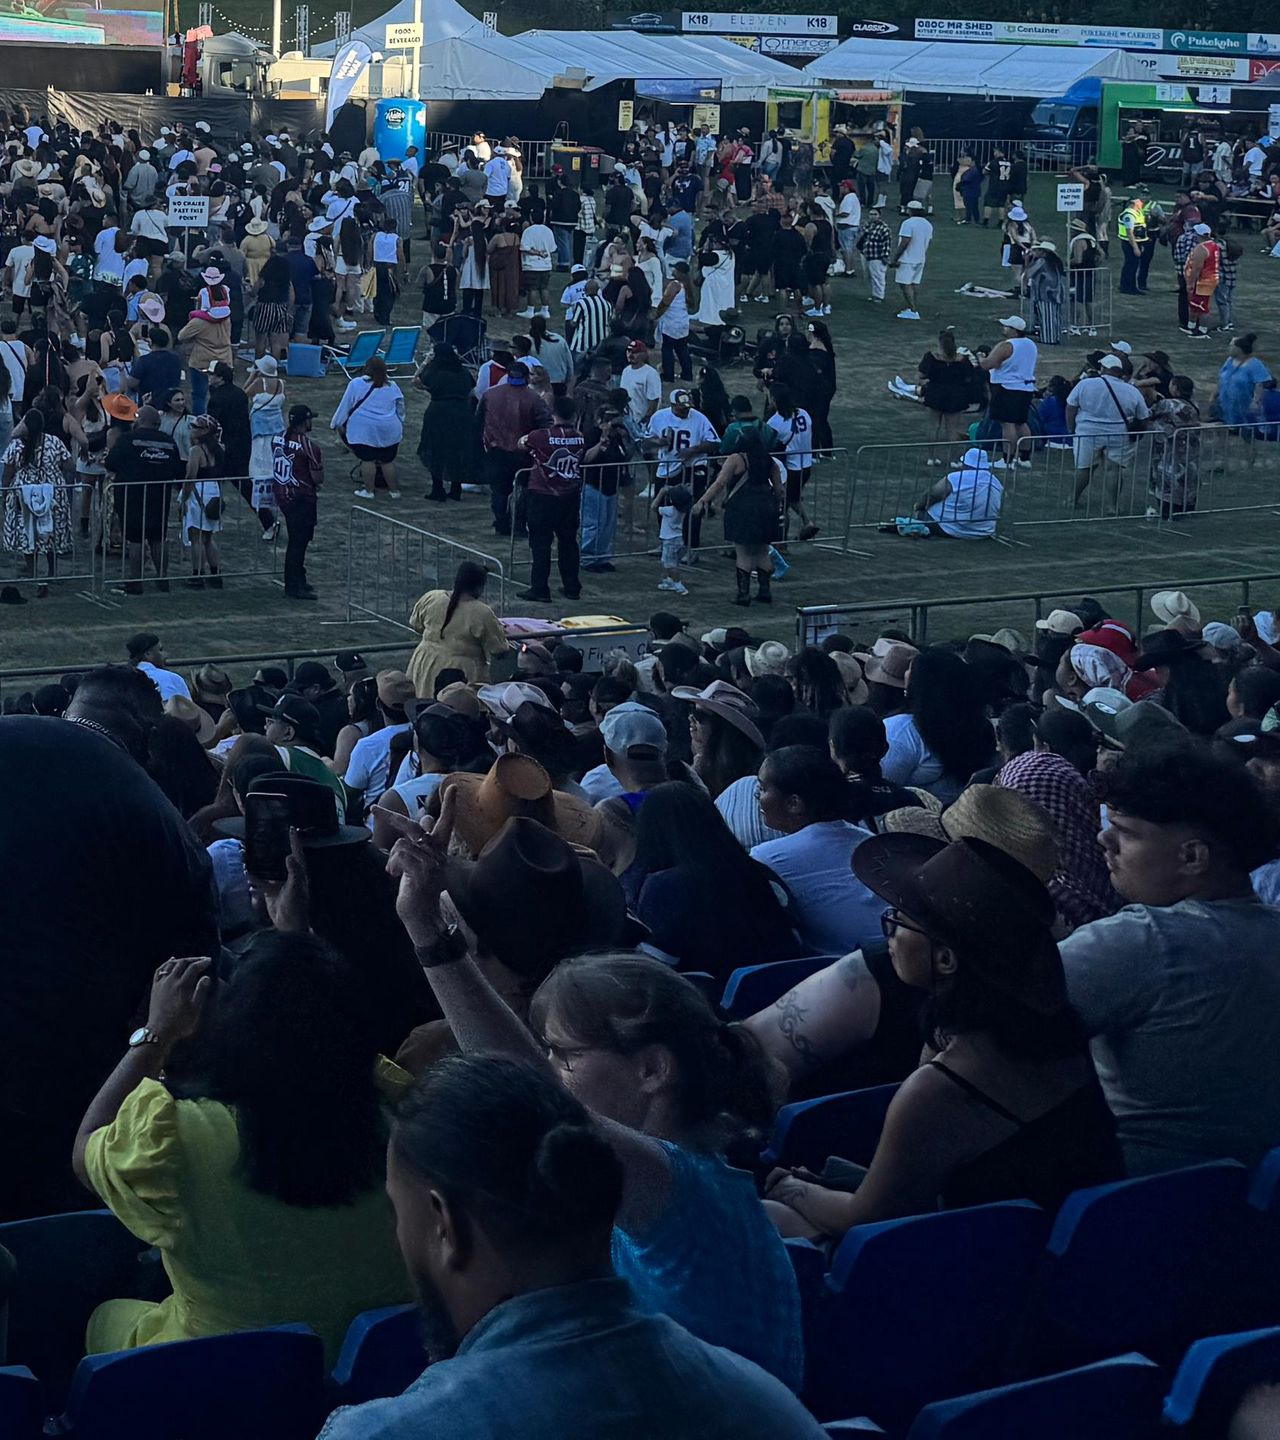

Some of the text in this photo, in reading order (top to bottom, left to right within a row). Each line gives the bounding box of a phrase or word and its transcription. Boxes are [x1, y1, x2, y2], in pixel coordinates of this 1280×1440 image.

[688, 15, 827, 28] K18 ELEVEN K18
[918, 21, 945, 29] 0800
[965, 22, 993, 30] SHED
[853, 23, 887, 32] CLASSIC
[1017, 25, 1059, 34] Container
[1127, 31, 1160, 39] CARRIERS
[782, 39, 831, 47] mercer
[1188, 36, 1239, 49] Pukekohe
